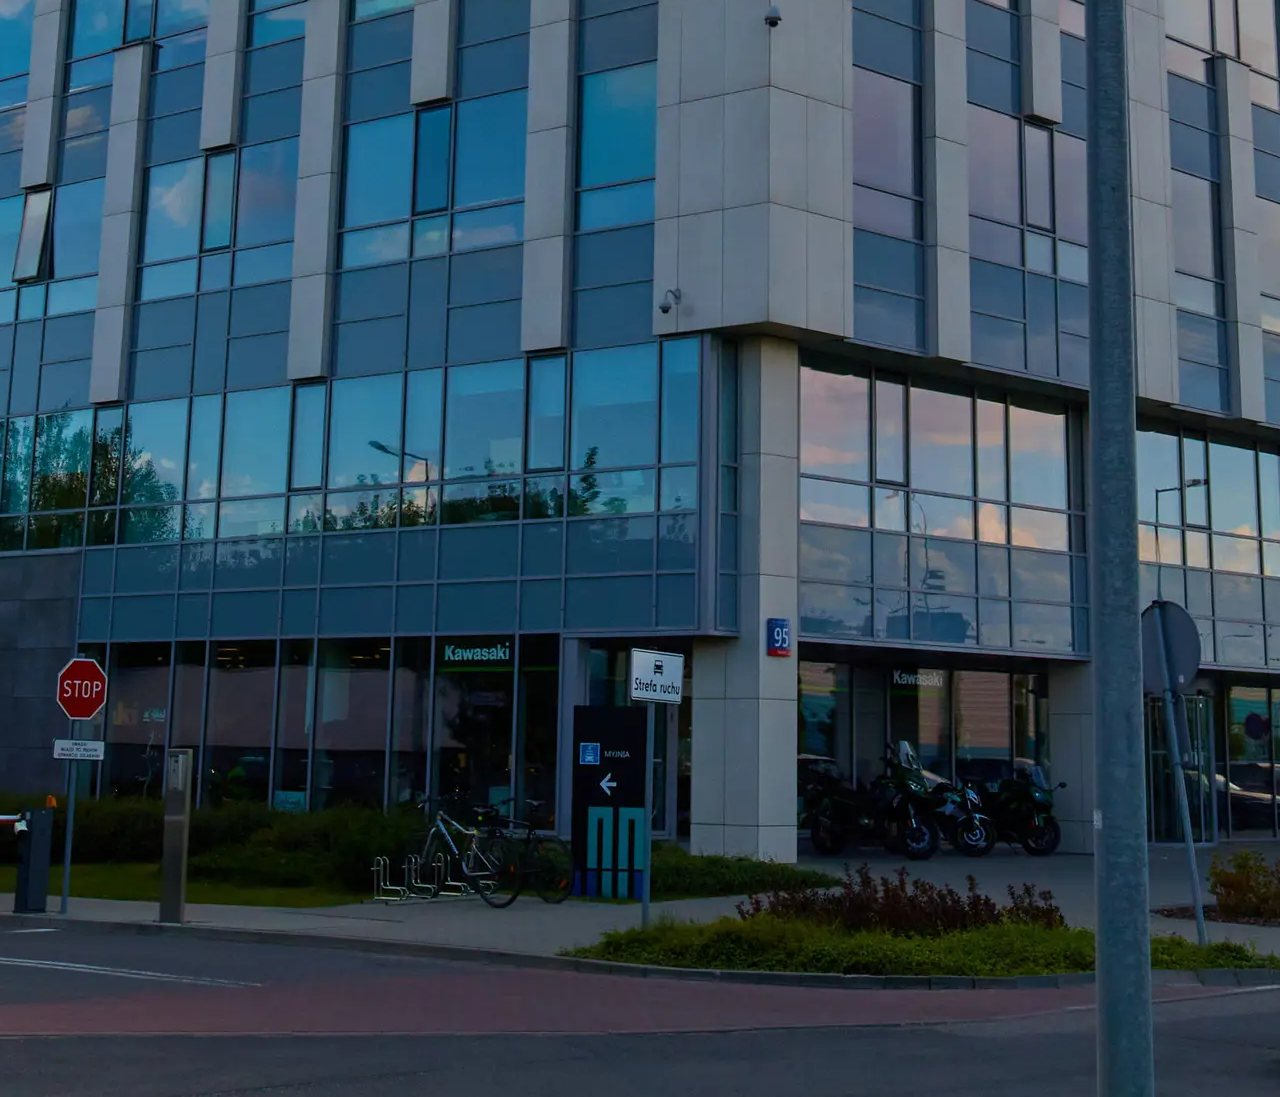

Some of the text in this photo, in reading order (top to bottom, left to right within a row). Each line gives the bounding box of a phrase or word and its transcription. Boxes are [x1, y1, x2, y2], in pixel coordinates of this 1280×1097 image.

[773, 627, 789, 647] 95
[444, 642, 510, 661] Kawasaki
[634, 677, 680, 695] Strefa ruchu
[893, 669, 943, 686] Kawasaki
[63, 680, 102, 698] STOP
[603, 749, 631, 758] MYJNIA
